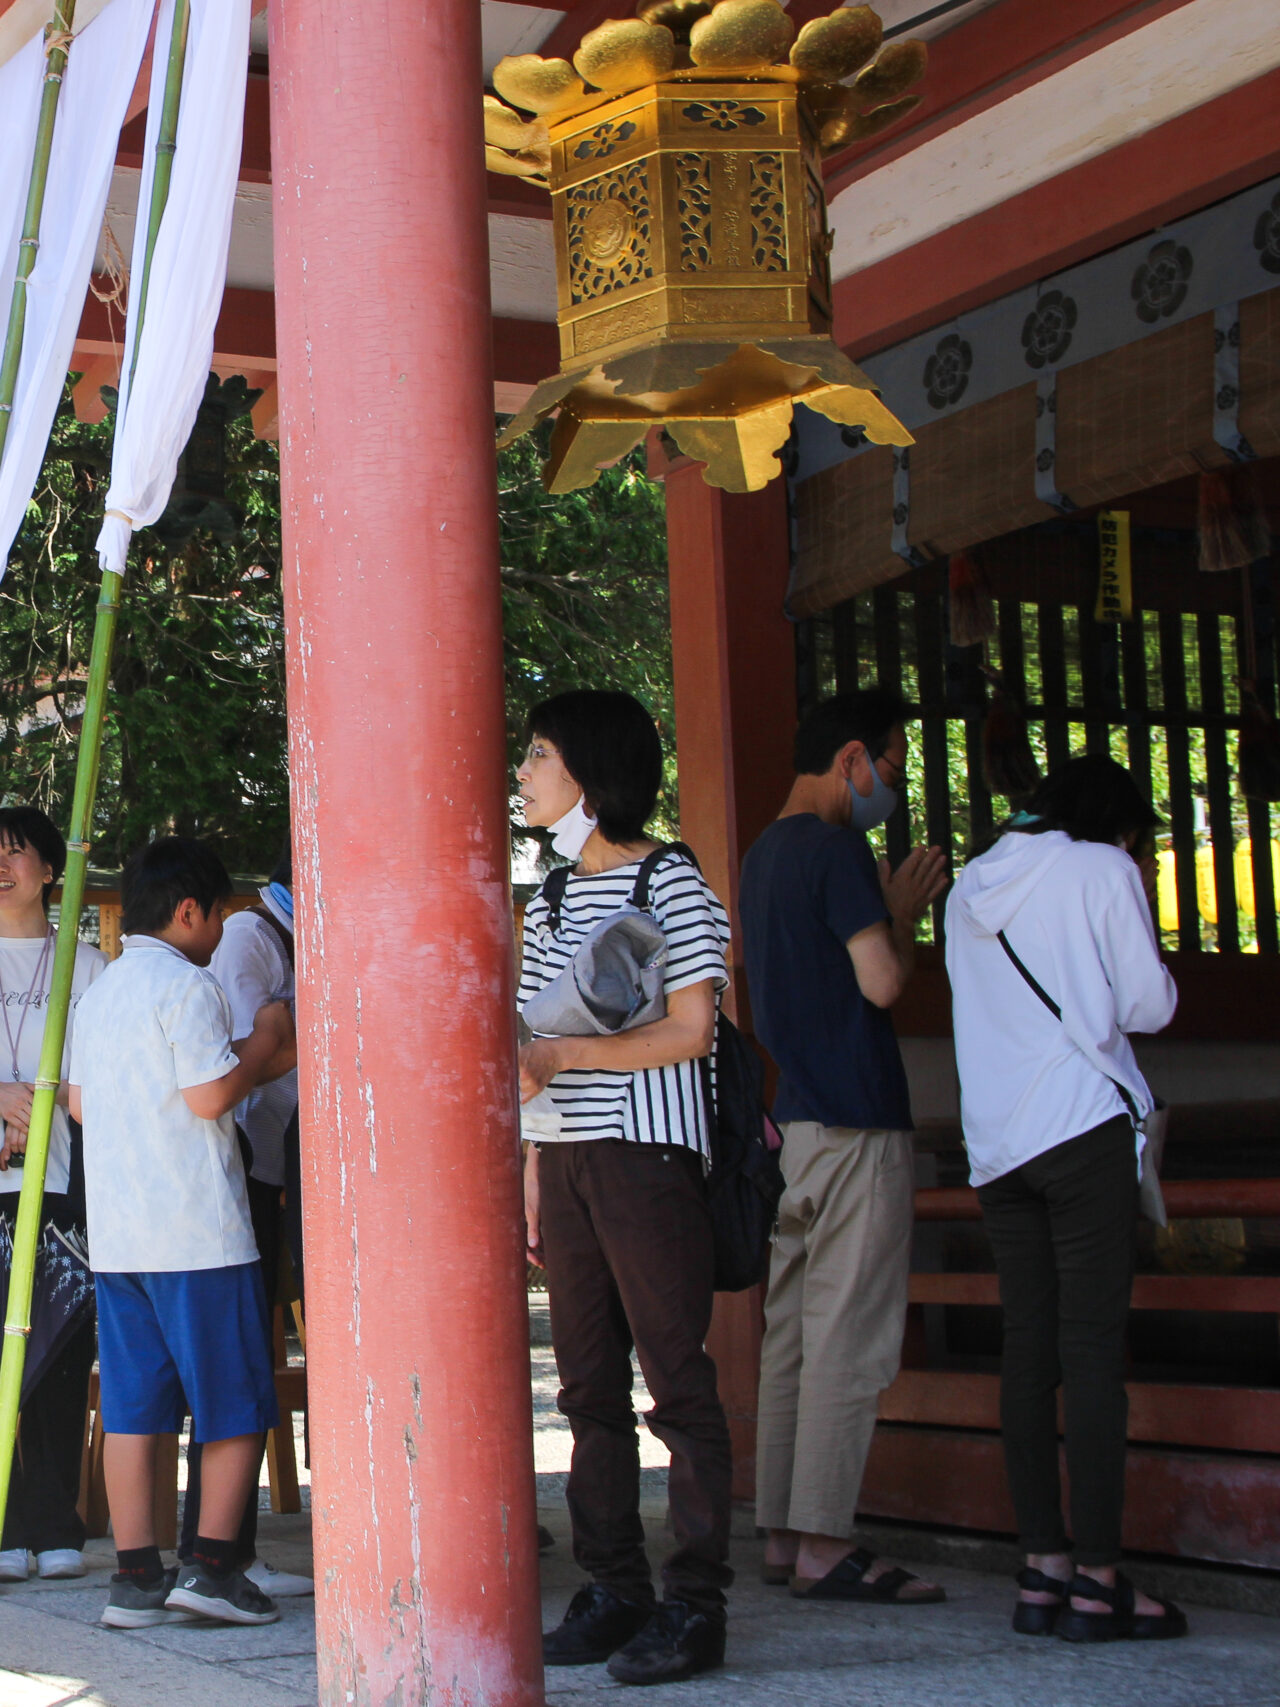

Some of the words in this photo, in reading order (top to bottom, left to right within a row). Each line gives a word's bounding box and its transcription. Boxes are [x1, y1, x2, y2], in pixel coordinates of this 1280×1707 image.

[1102, 519, 1122, 619] 防犯カメラ作動中
